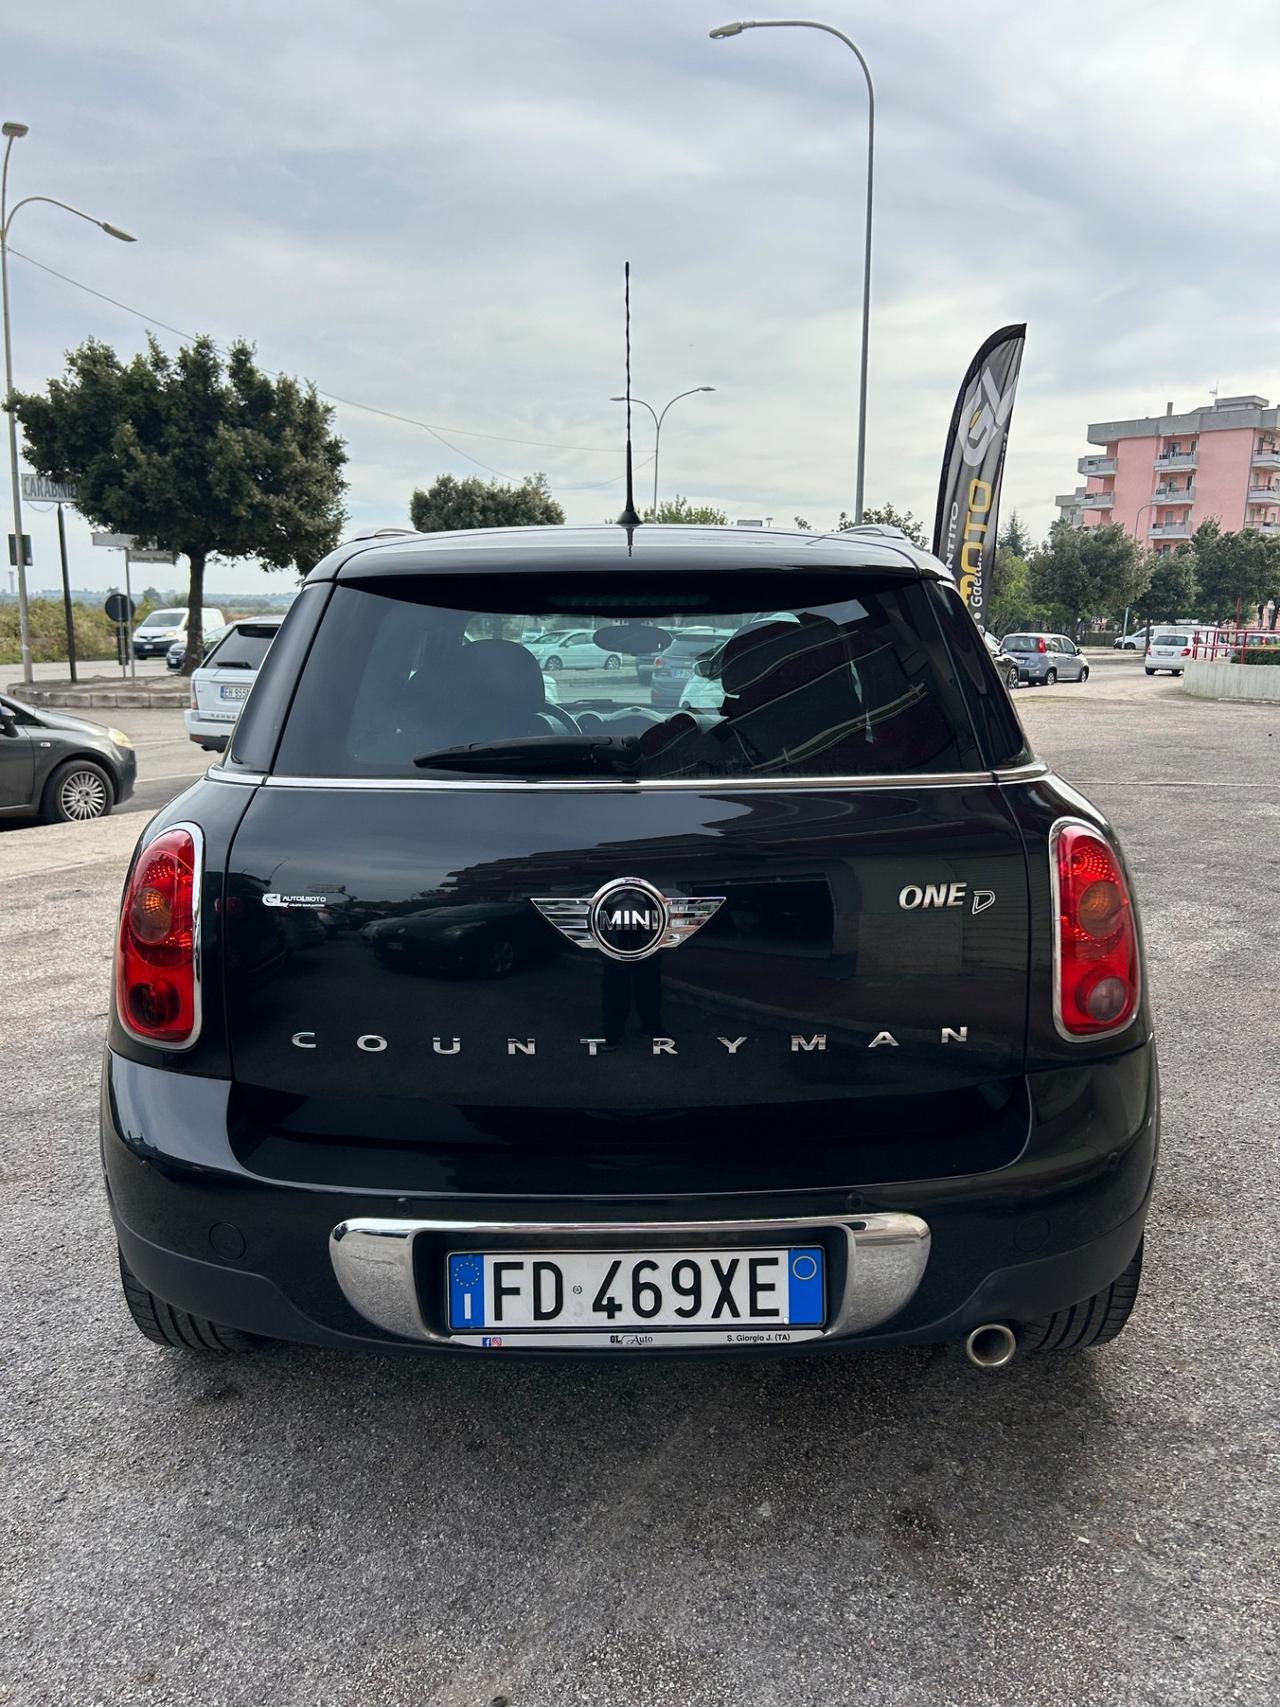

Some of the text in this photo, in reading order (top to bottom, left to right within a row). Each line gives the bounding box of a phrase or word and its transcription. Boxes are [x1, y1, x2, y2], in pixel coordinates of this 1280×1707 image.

[946, 502, 959, 573] NTITO
[899, 882, 996, 915] ONE D
[600, 910, 659, 930] MINI
[292, 1026, 968, 1055] COUNTRYMAN
[493, 1261, 563, 1321] FD
[592, 1257, 780, 1319] 469XE
[726, 1334, 734, 1342] S.
[736, 1334, 764, 1342] Giorgio
[775, 1333, 790, 1341] (TA)
